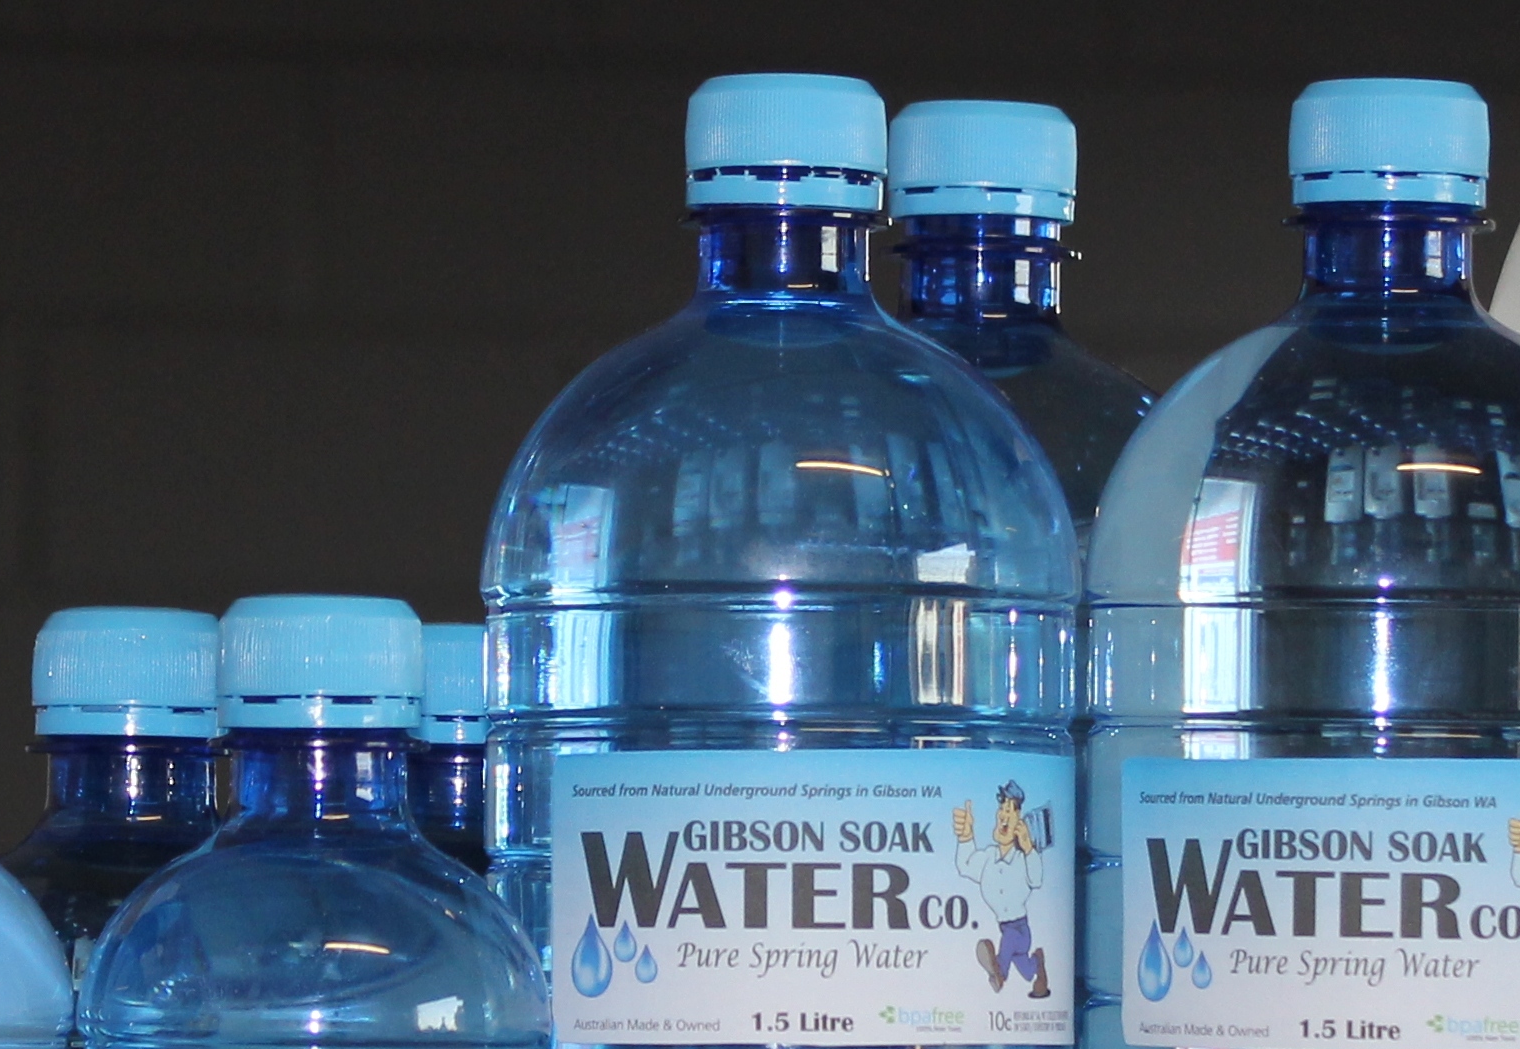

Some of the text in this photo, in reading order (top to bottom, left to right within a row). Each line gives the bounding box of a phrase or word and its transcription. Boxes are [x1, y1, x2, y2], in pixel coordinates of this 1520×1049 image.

[573, 783, 942, 800] Sourced from Natural Underground Springs in Gibson WA
[1139, 791, 1497, 811] Sourced from Natural Underground Springs in Gibson WA
[683, 820, 934, 853] GIBSON SOAK
[1236, 828, 1487, 863] GIBSON SOAK
[581, 831, 979, 930] WATER CO.
[1146, 837, 1462, 940] WATER
[677, 939, 928, 978] Pure Spring Water
[1229, 948, 1479, 985] Pure Spring Water
[573, 1018, 721, 1033] Australian Made & Owned
[751, 1013, 854, 1033] 1.5 Litre
[898, 1006, 965, 1028] bpafree
[989, 1010, 1012, 1033] 10c
[1447, 1017, 1519, 1038] bpafree
[1139, 1023, 1270, 1039] Australian Made & Owned
[1299, 1019, 1401, 1040] 1.5 Litre
